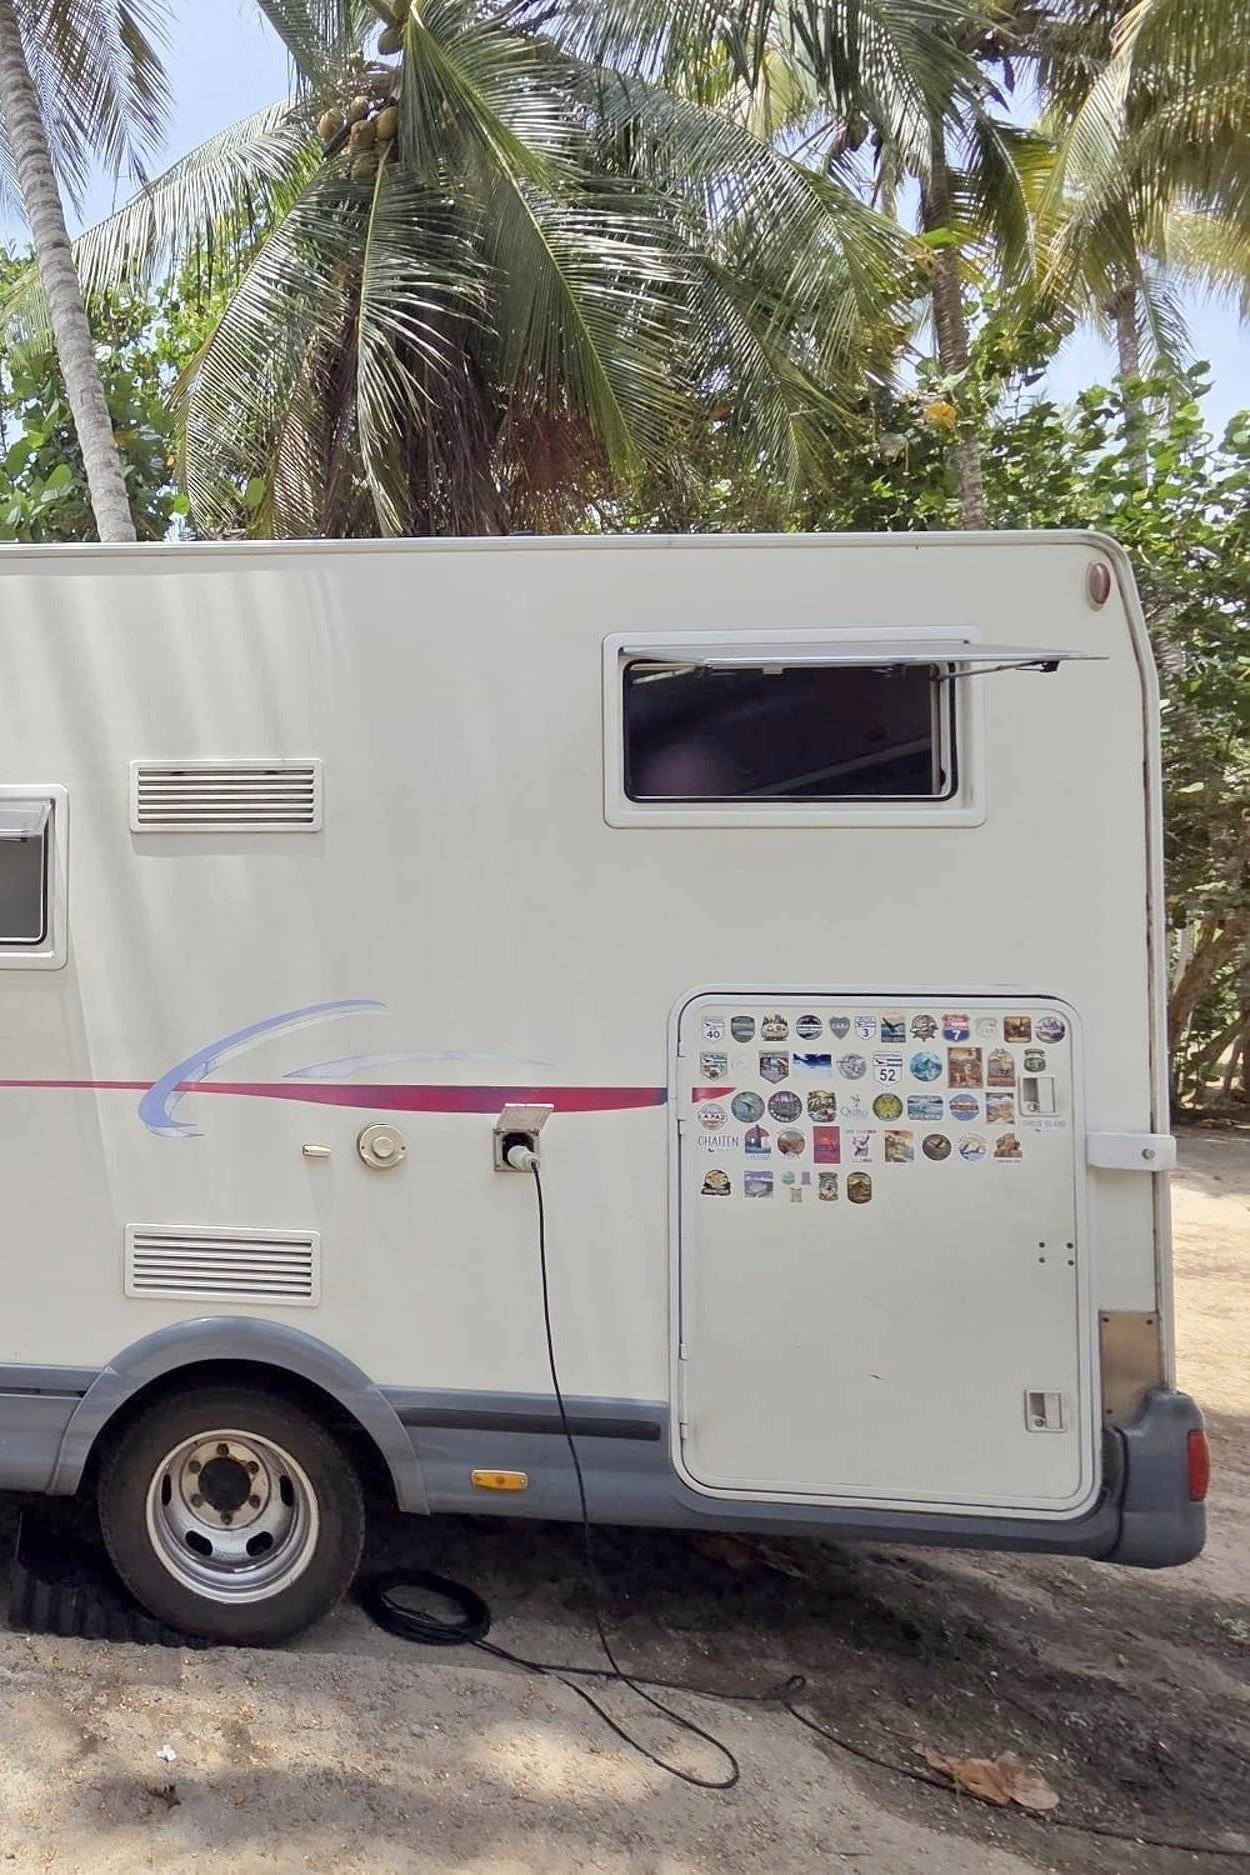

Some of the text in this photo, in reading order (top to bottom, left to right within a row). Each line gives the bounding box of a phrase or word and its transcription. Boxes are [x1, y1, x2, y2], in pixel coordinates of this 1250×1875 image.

[706, 1031, 720, 1039] 40
[863, 1028, 870, 1037] 3
[952, 1030, 960, 1041] 7
[879, 1069, 896, 1082] 52
